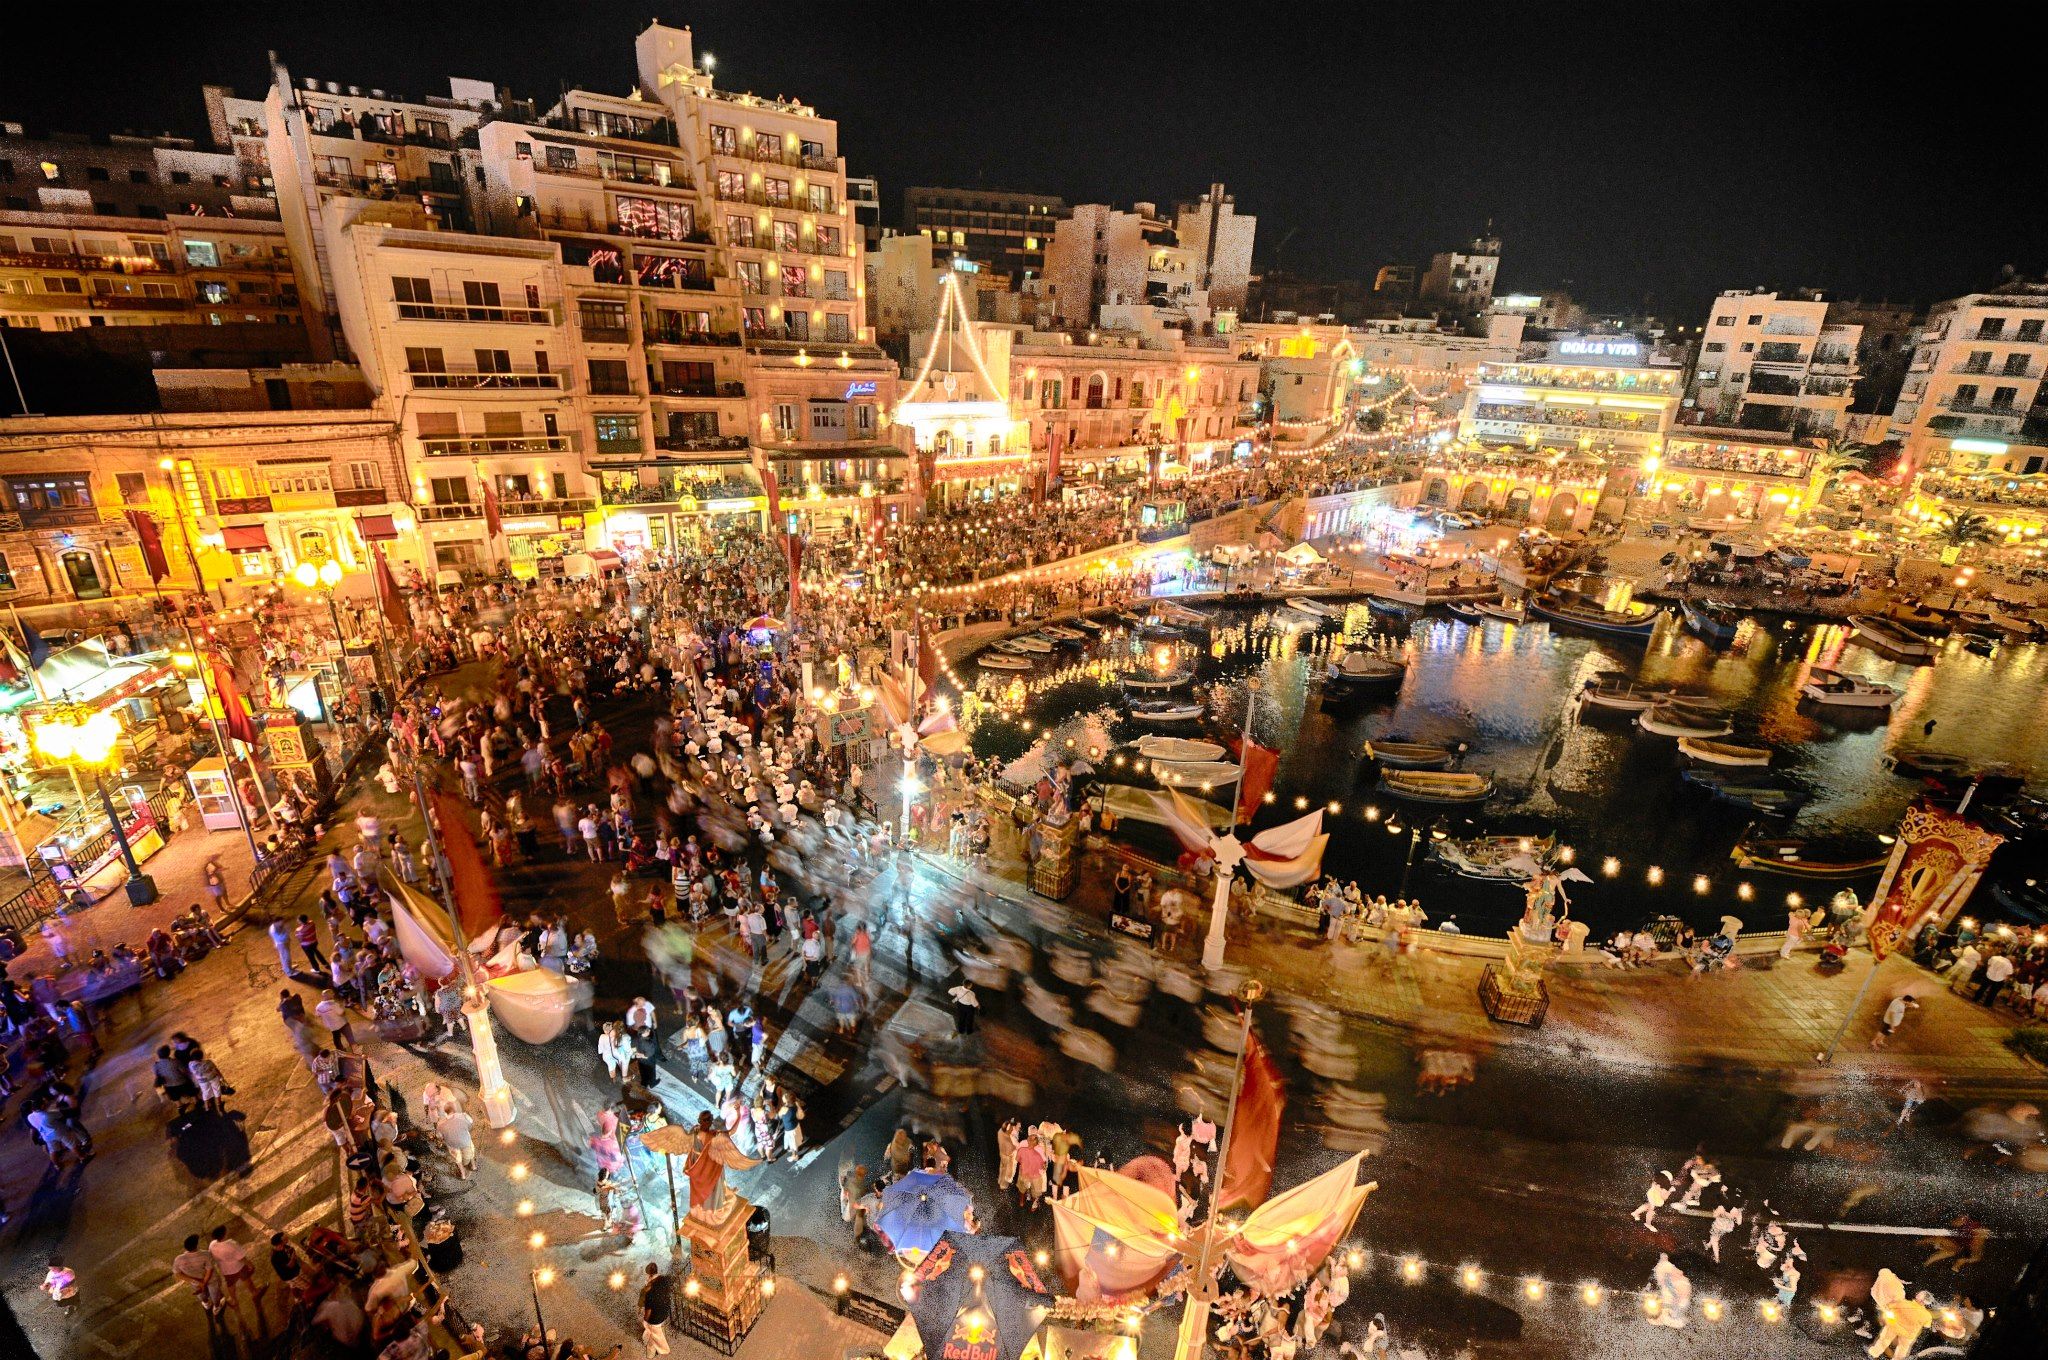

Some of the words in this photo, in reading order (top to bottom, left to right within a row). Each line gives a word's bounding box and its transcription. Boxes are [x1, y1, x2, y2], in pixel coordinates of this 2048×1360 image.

[1560, 341, 1605, 354] DOLCE
[1607, 343, 1638, 356] VITA
[1503, 428, 1568, 439] Papaazzi
[943, 1342, 971, 1360] Red
[971, 1344, 997, 1360] Bull
